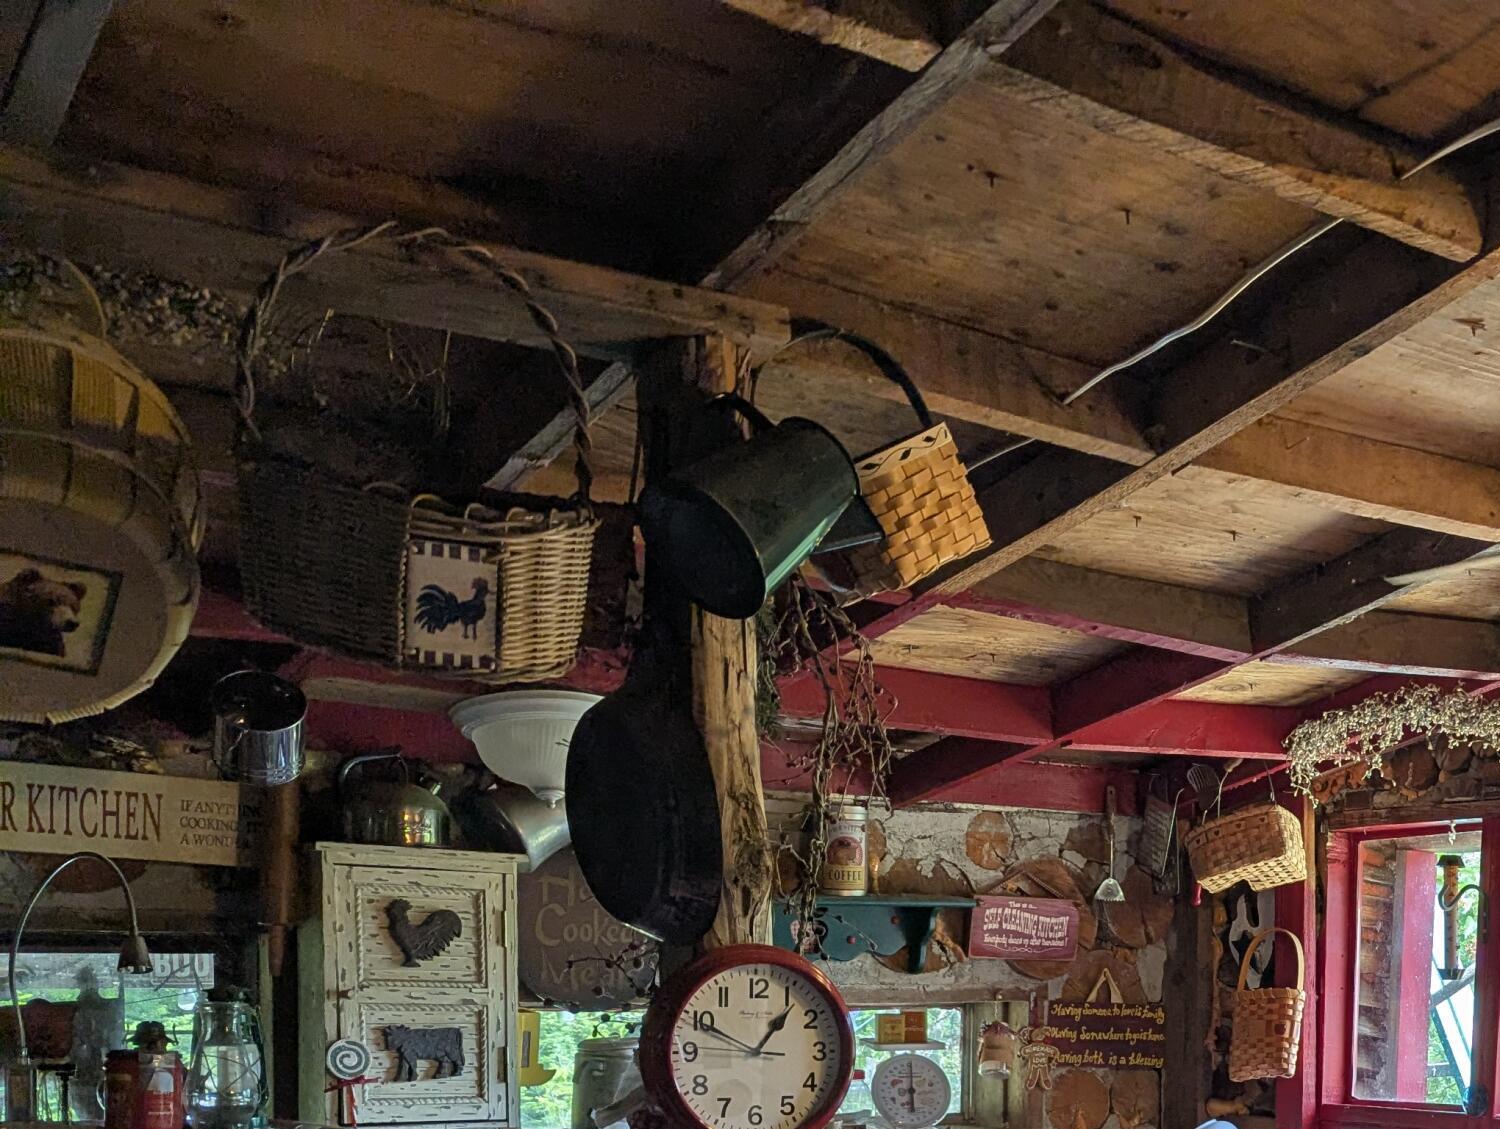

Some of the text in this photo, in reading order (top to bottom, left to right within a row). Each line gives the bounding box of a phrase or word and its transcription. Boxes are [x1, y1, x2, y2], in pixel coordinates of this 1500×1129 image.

[26, 783, 164, 843] KITCHEN
[180, 799, 193, 812] IF
[180, 833, 190, 846] A
[983, 908, 1070, 939] SELF CLEANING KITCHEN
[718, 986, 729, 1008] 11
[749, 978, 769, 999] 12
[785, 986, 790, 1007] 1
[693, 1010, 715, 1032] 10
[803, 1009, 819, 1030] 2
[682, 1041, 698, 1063] 9
[812, 1041, 827, 1062] 3
[1083, 1050, 1105, 1065] both
[1108, 1052, 1118, 1065] is
[1119, 1056, 1127, 1065] a
[692, 1075, 709, 1096] 8
[802, 1072, 818, 1093] 4
[716, 1097, 732, 1119] 7
[747, 1104, 763, 1126] 6
[779, 1095, 795, 1116] 5
